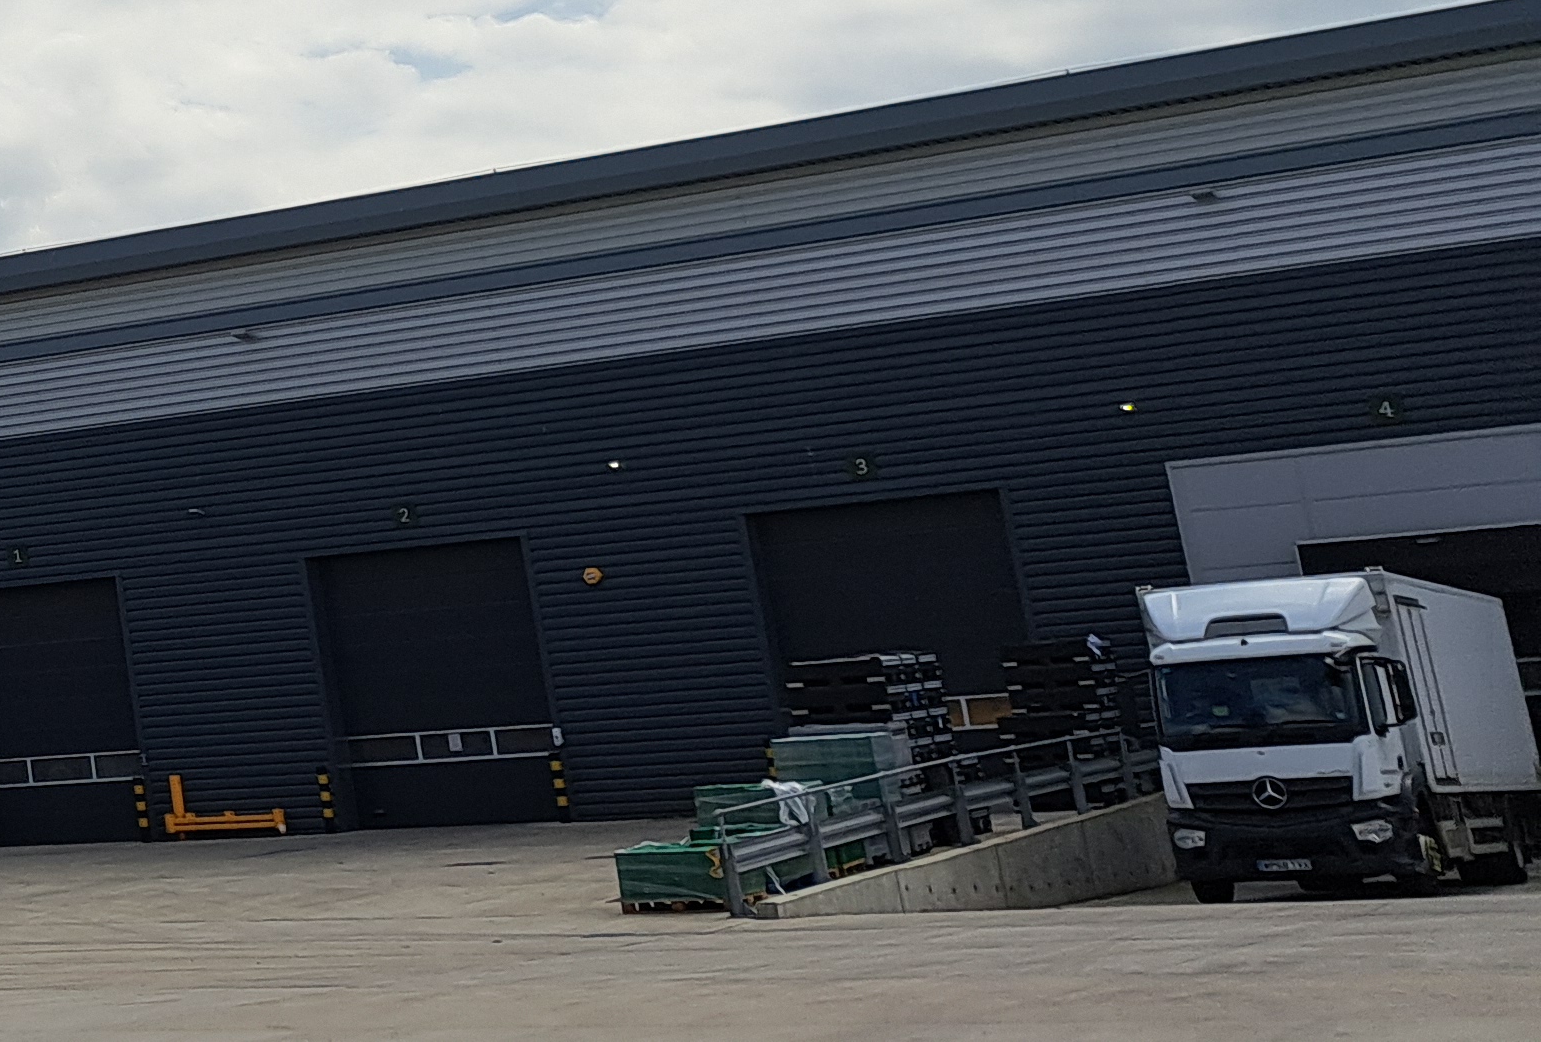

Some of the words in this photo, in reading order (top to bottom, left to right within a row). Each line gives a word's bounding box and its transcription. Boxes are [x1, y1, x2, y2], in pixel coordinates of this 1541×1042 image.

[1378, 401, 1394, 417] 4
[856, 458, 867, 475] 3
[399, 508, 410, 522] 2
[13, 549, 22, 562] 1
